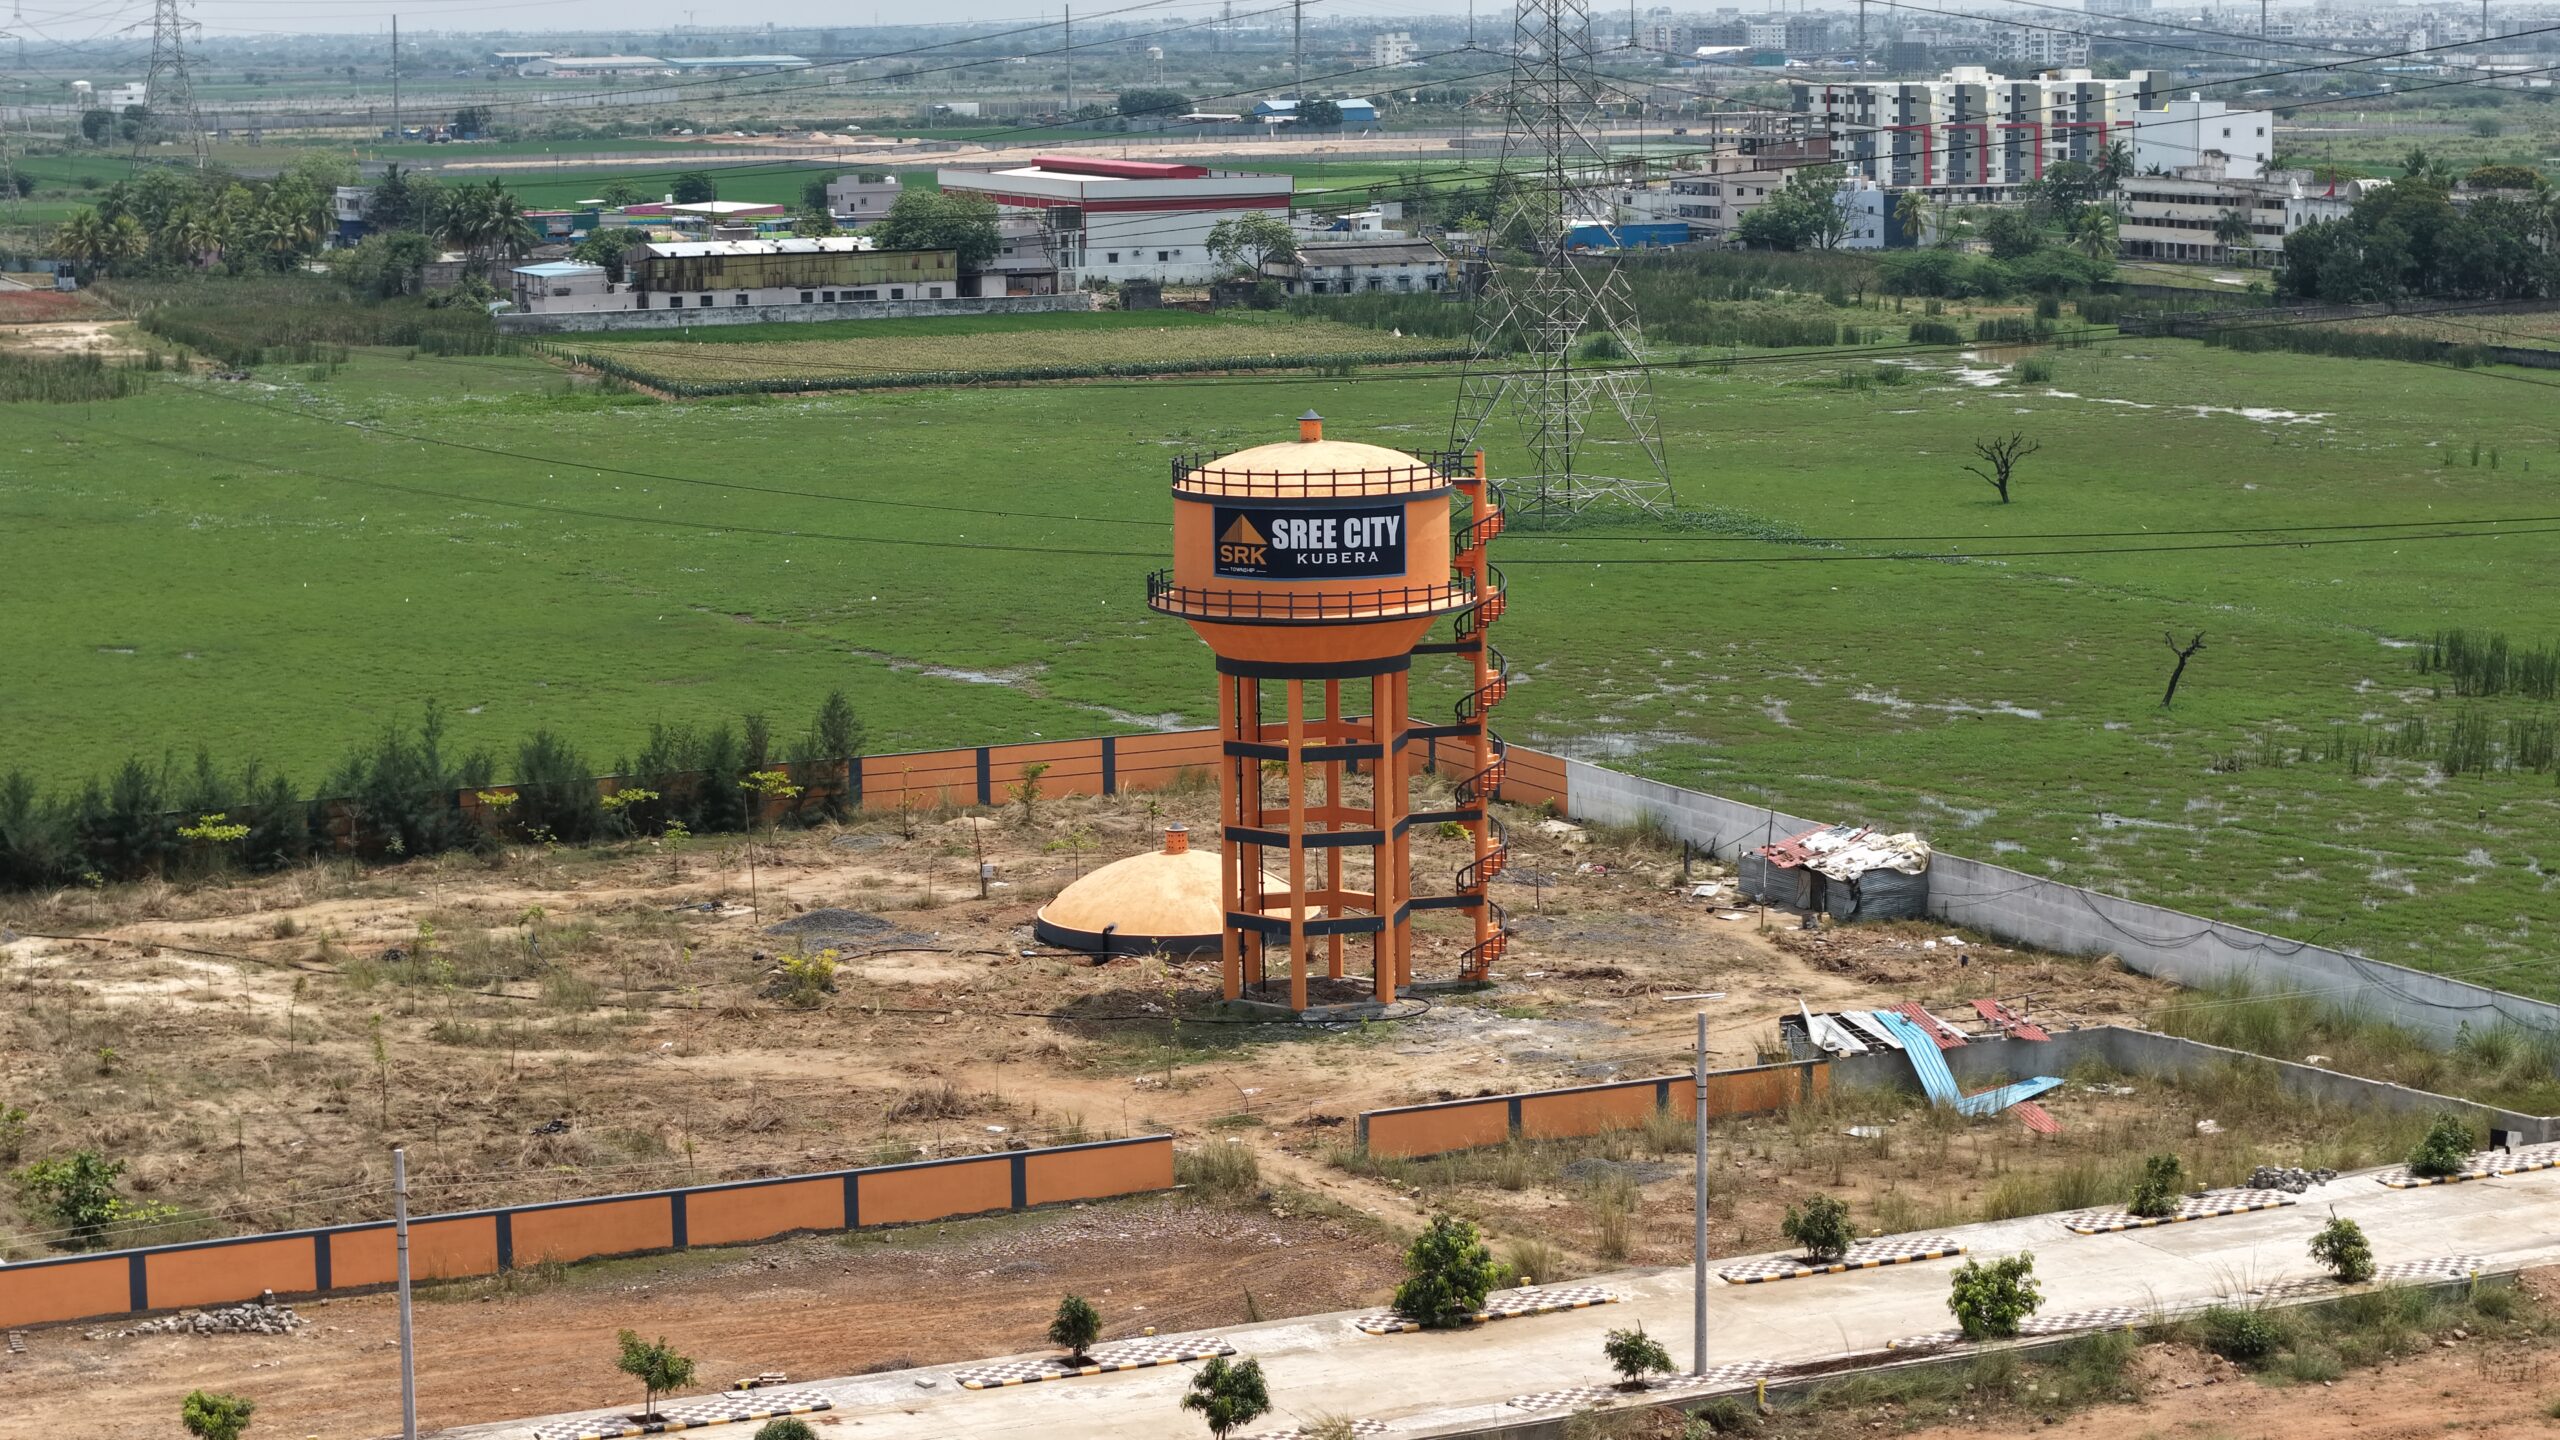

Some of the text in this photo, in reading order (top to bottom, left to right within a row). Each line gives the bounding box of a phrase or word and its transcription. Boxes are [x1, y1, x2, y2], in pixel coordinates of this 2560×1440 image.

[1271, 515, 1400, 549] SREE CITY
[1220, 545, 1267, 565] SRK
[1297, 551, 1379, 564] KUBERA
